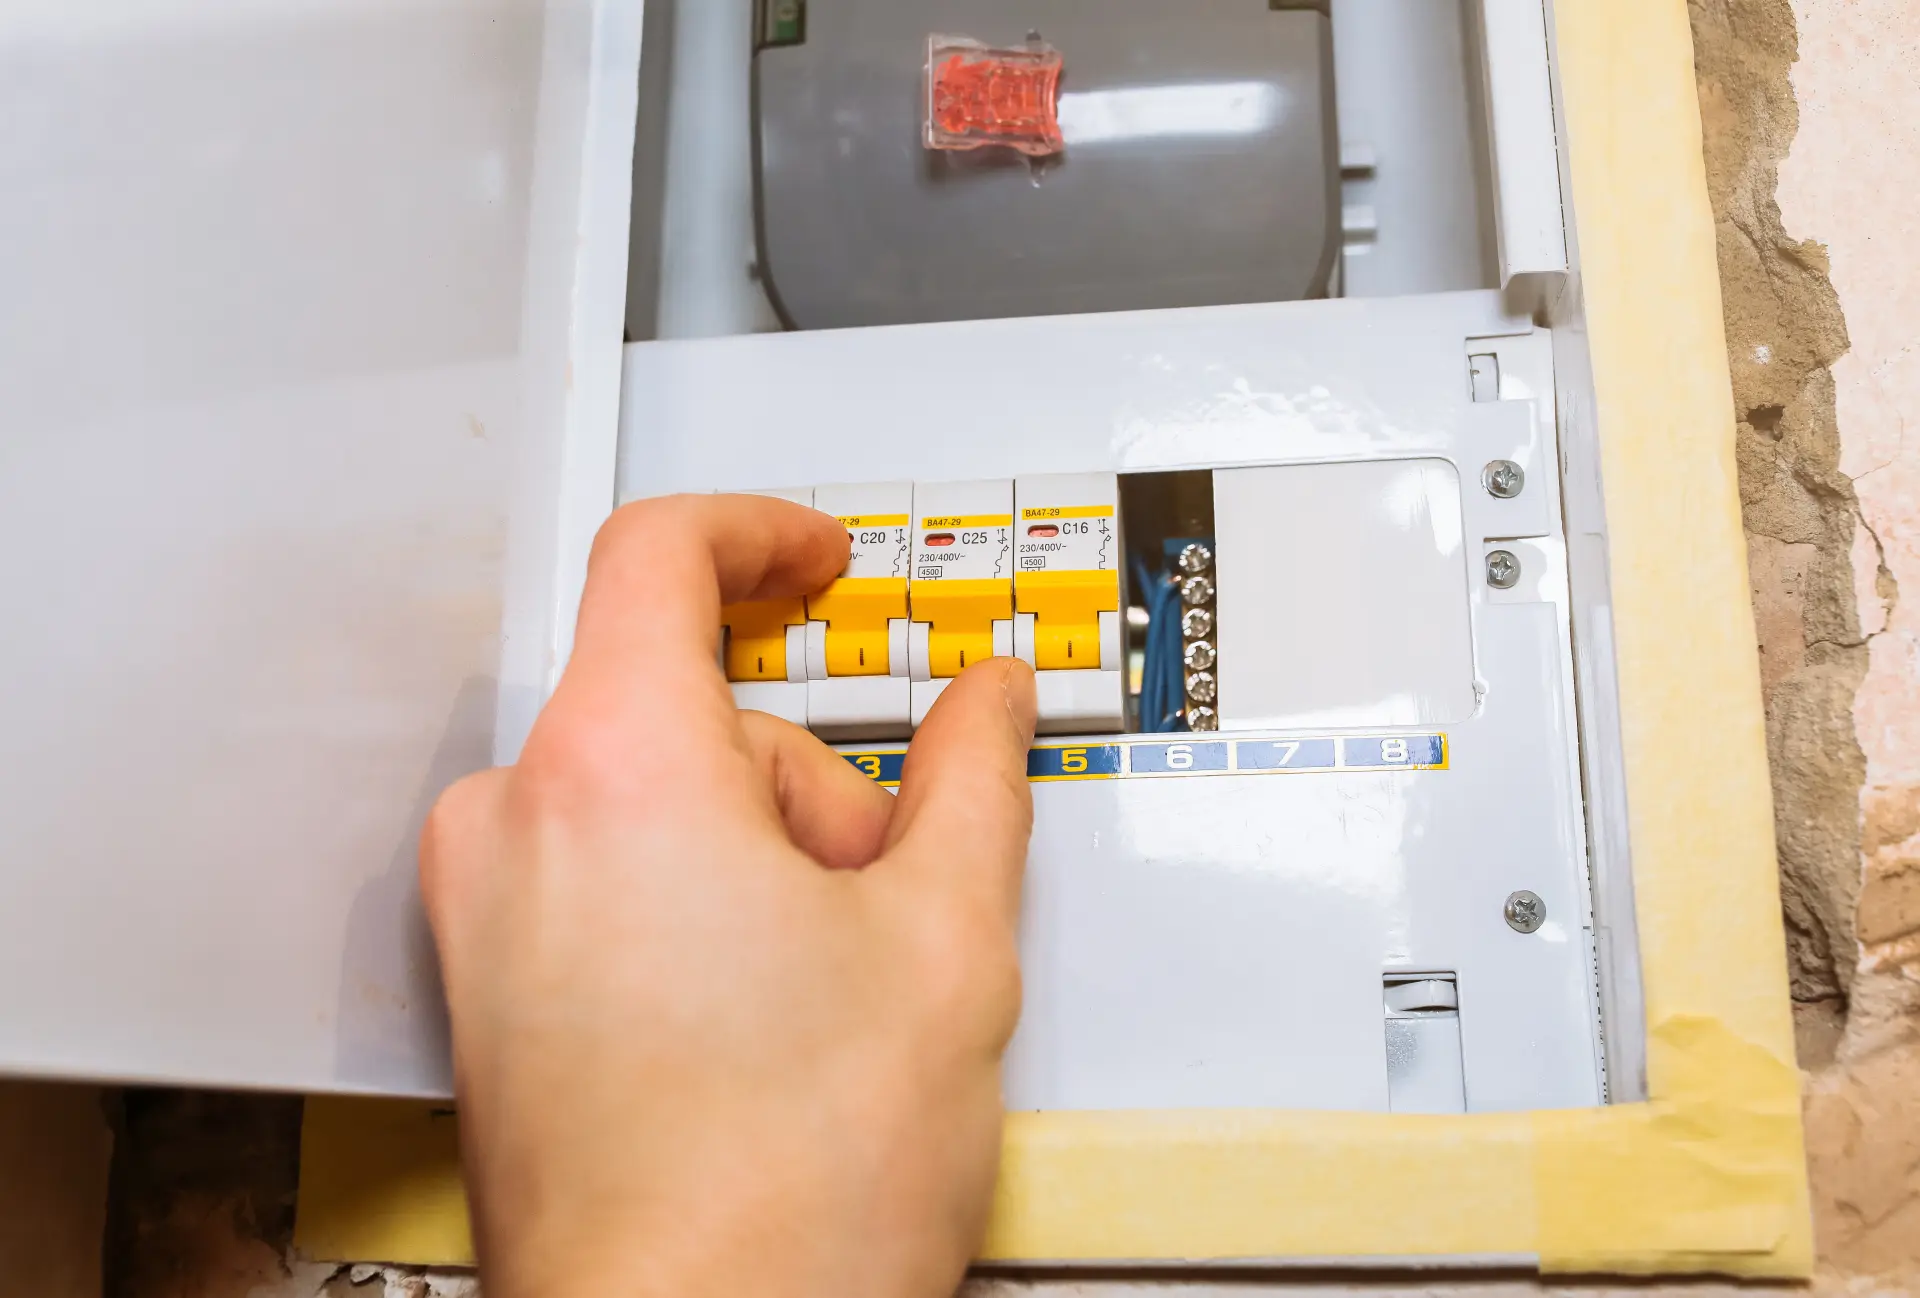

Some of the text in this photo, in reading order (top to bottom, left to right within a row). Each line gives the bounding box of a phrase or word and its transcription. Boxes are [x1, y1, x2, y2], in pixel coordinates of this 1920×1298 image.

[1025, 508, 1060, 517] BA47-29
[838, 518, 860, 526] 7-29
[927, 518, 962, 526] BA47-29
[1062, 522, 1089, 534] C16
[860, 532, 886, 544] C20
[962, 531, 988, 544] C25
[855, 738, 1408, 779] 3 5 6 7 8
